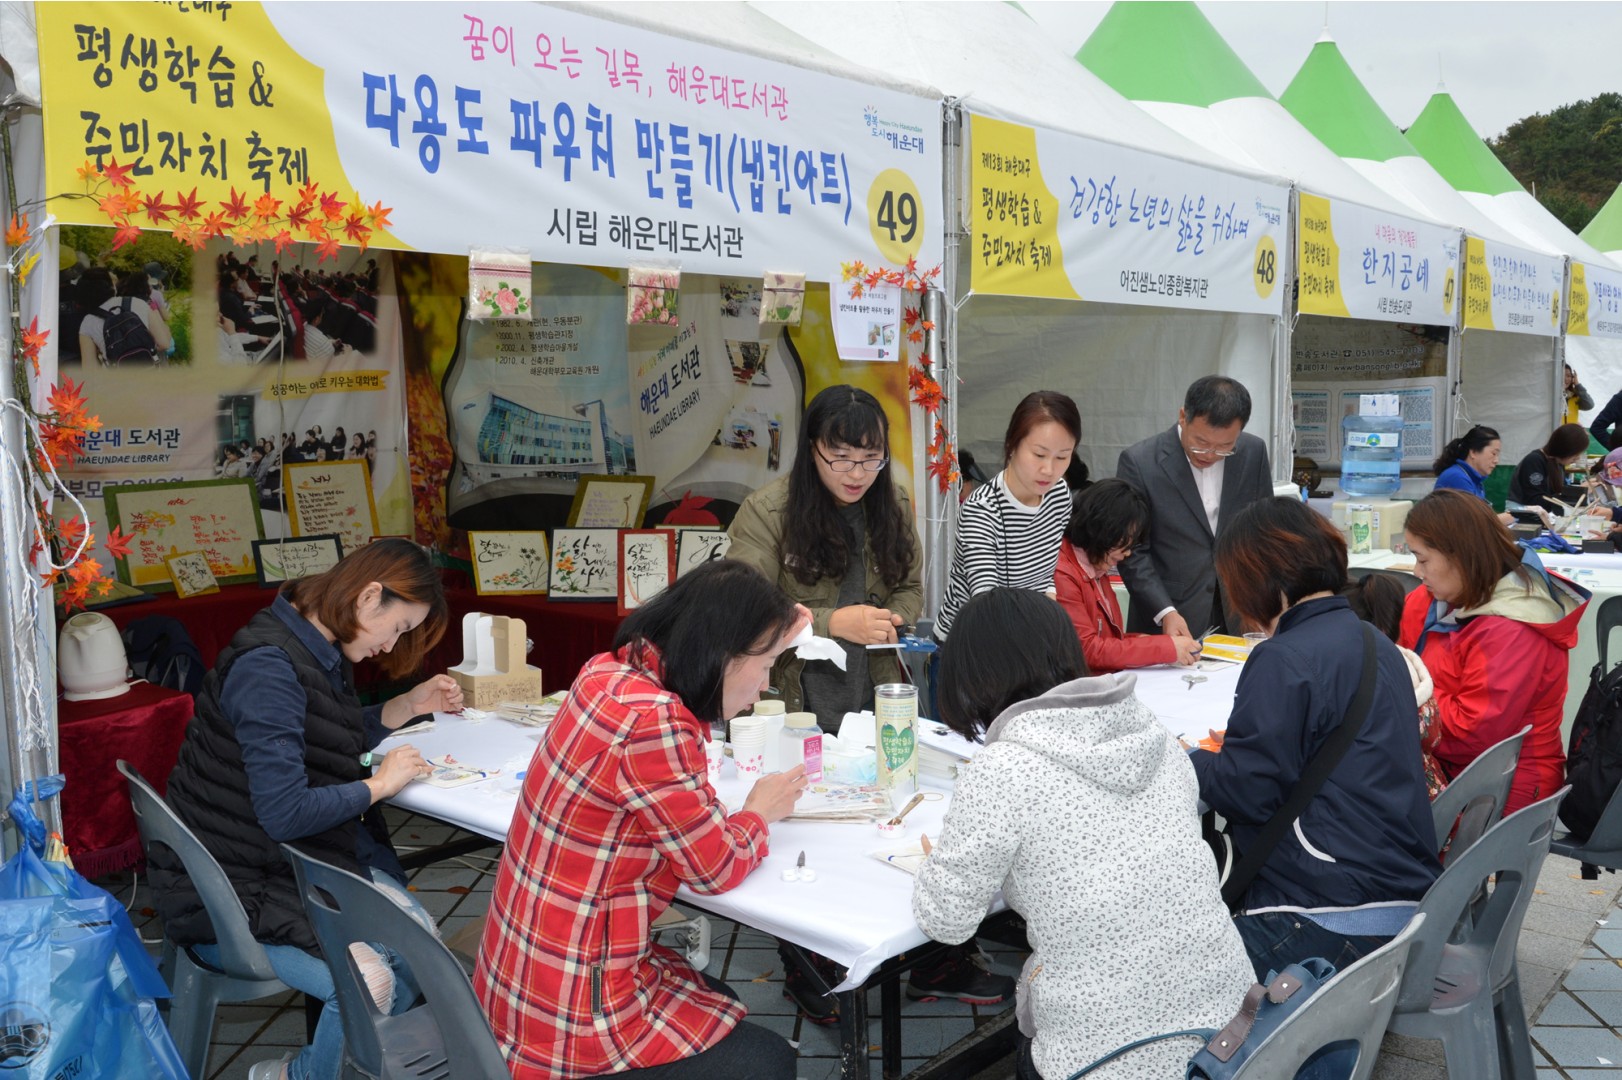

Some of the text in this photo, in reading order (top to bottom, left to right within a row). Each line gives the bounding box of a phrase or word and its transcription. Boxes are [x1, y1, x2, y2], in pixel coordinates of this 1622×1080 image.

[74, 24, 274, 108] 평생학습 &
[463, 14, 789, 121] 꿈이 오는 길목, 해운대도서관
[80, 110, 309, 193] 주민자치 축제
[362, 70, 853, 226] 다용도 파우치 만들기(냅킨아트)
[886, 132, 924, 154] 해운대
[982, 152, 1031, 178] 제13회 해운대구
[877, 190, 917, 243] 49
[981, 187, 1042, 227] 평생학습 &
[1070, 175, 1249, 256] 건강한 노년의 삶을 위하며
[547, 207, 744, 259] 시립 해운대도서관
[982, 233, 1052, 273] 주민자치 축제
[1120, 270, 1209, 299] 어진샘노인종합복지관
[1257, 249, 1274, 284] 48
[1363, 247, 1429, 293] 한지공예
[529, 329, 574, 341] 평생학습관지정
[271, 382, 307, 396] 성공하는
[330, 375, 353, 388] 키우는
[355, 375, 379, 387] 대화법
[640, 345, 701, 415] 해운대 도서관
[649, 388, 701, 440] HAEUNDAE LIBRARY
[78, 454, 170, 464] HAEUNDAE LIBRARY
[128, 428, 180, 449] 도서관
